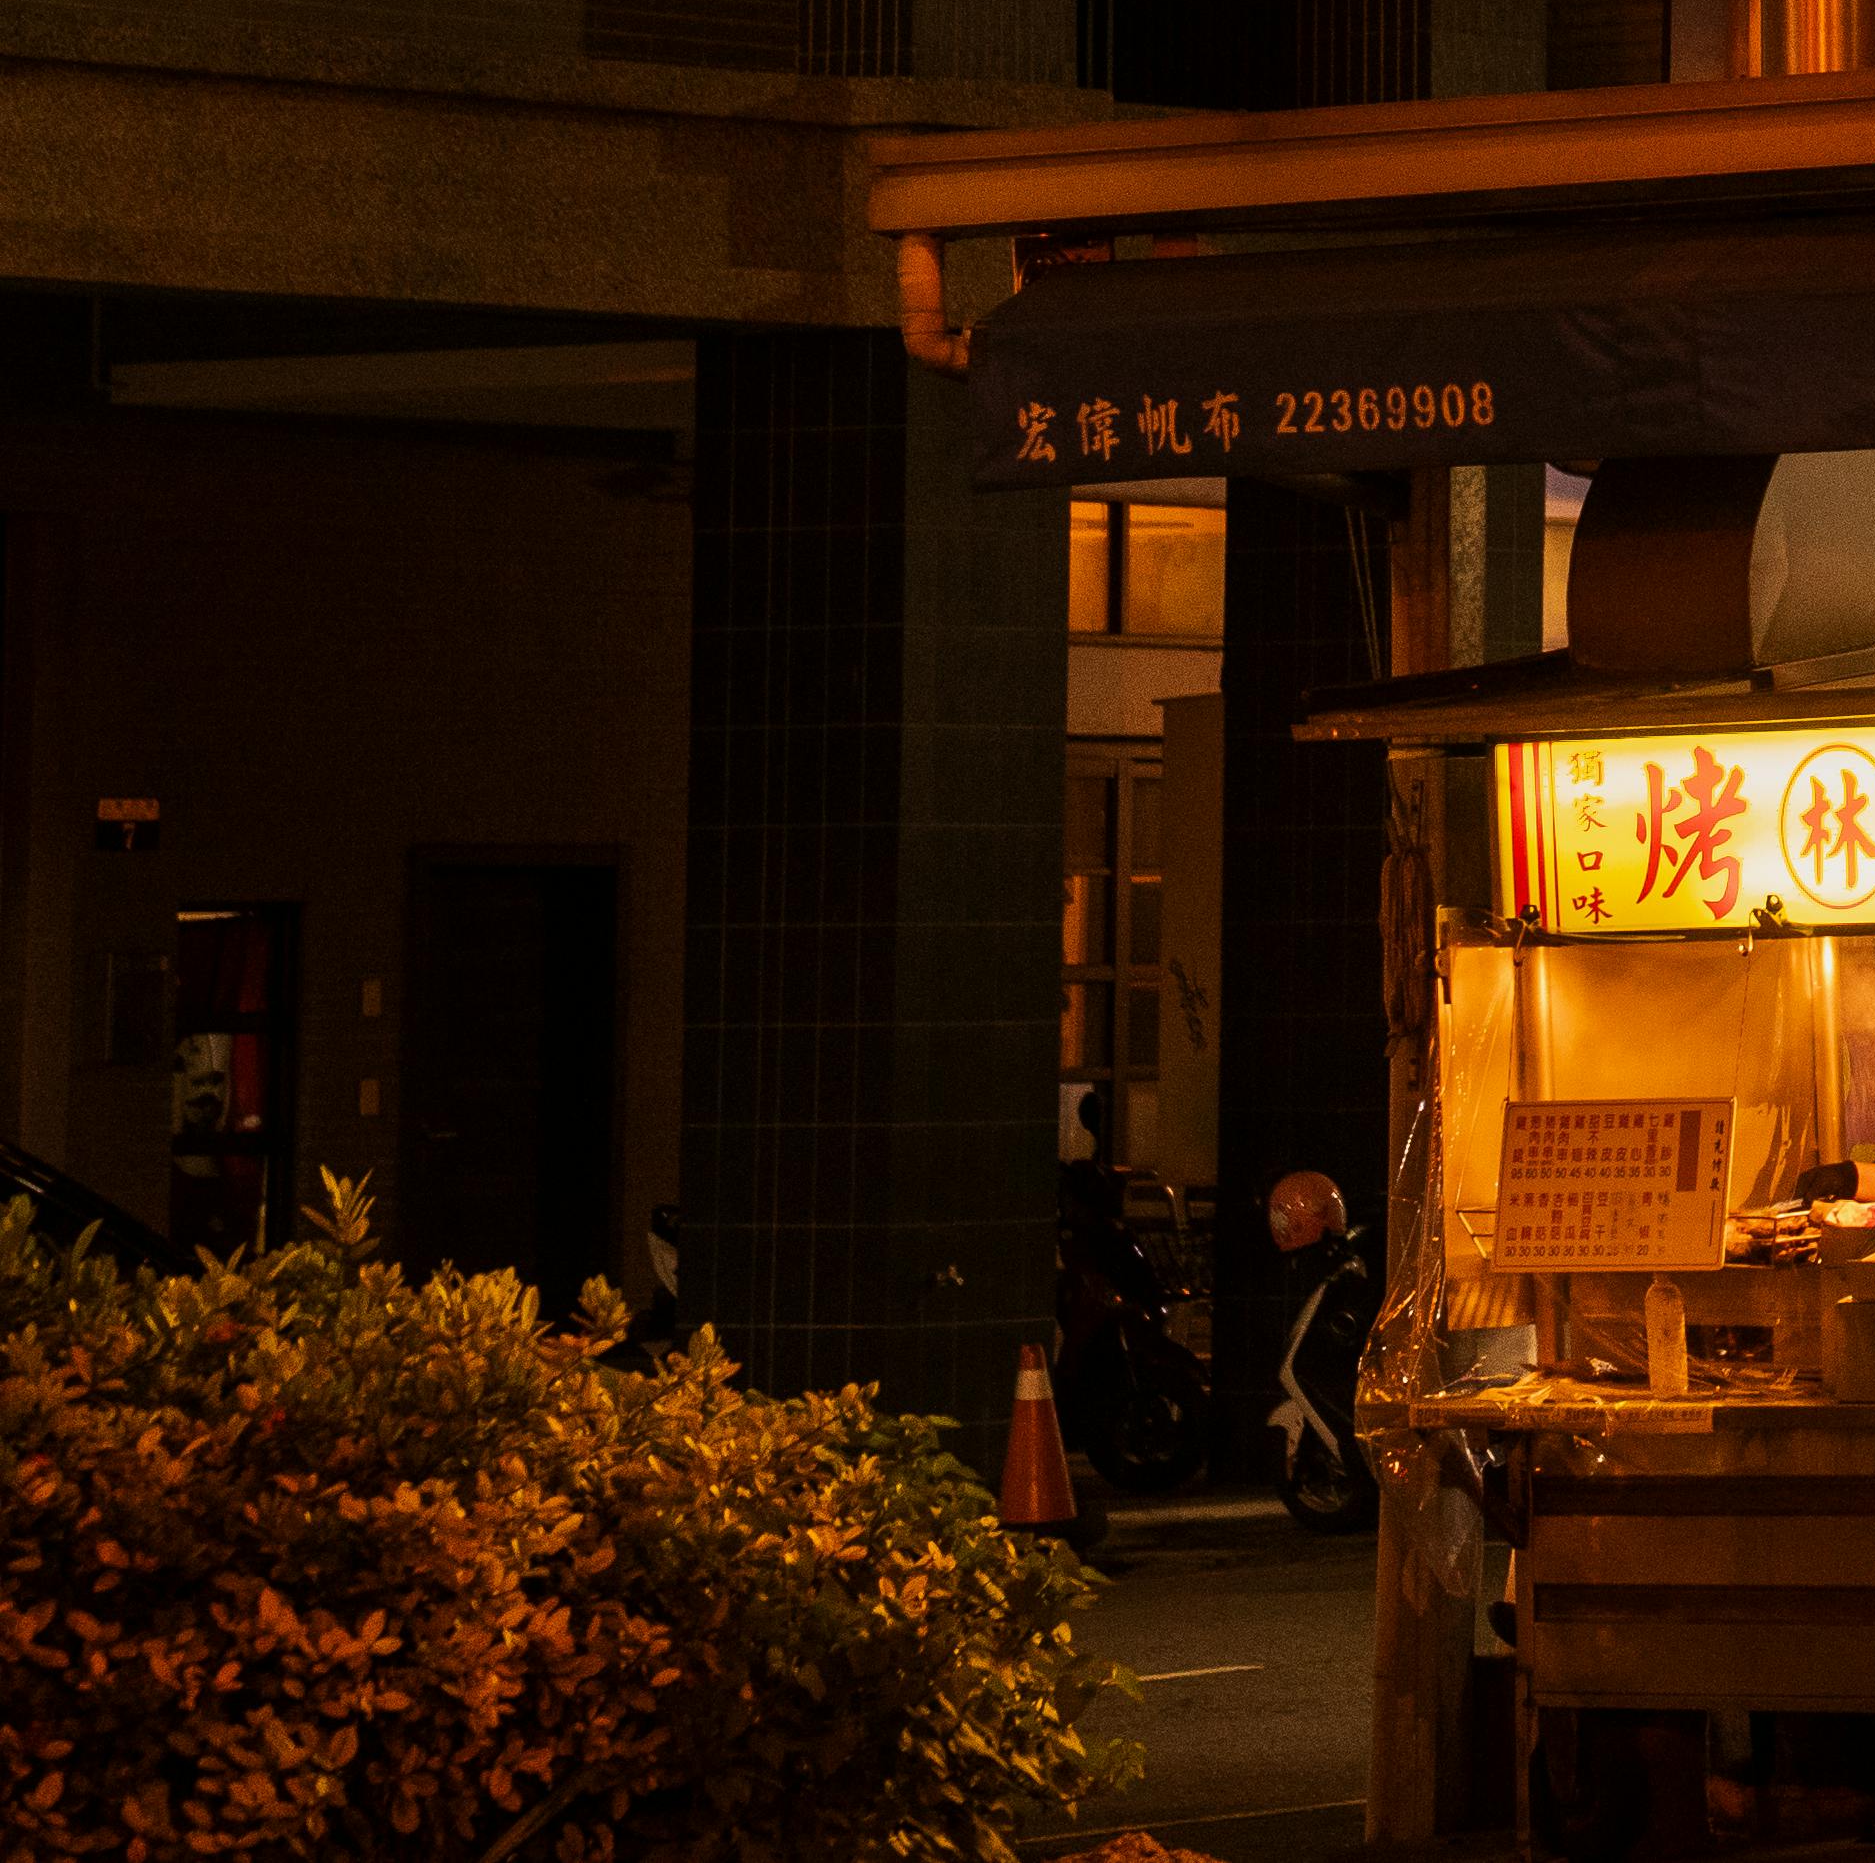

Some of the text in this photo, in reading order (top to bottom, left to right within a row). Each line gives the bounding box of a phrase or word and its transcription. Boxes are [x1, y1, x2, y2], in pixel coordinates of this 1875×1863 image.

[1014, 380, 1496, 464] 宏偉帆布 22369908
[1569, 748, 1613, 926] 獨家口味
